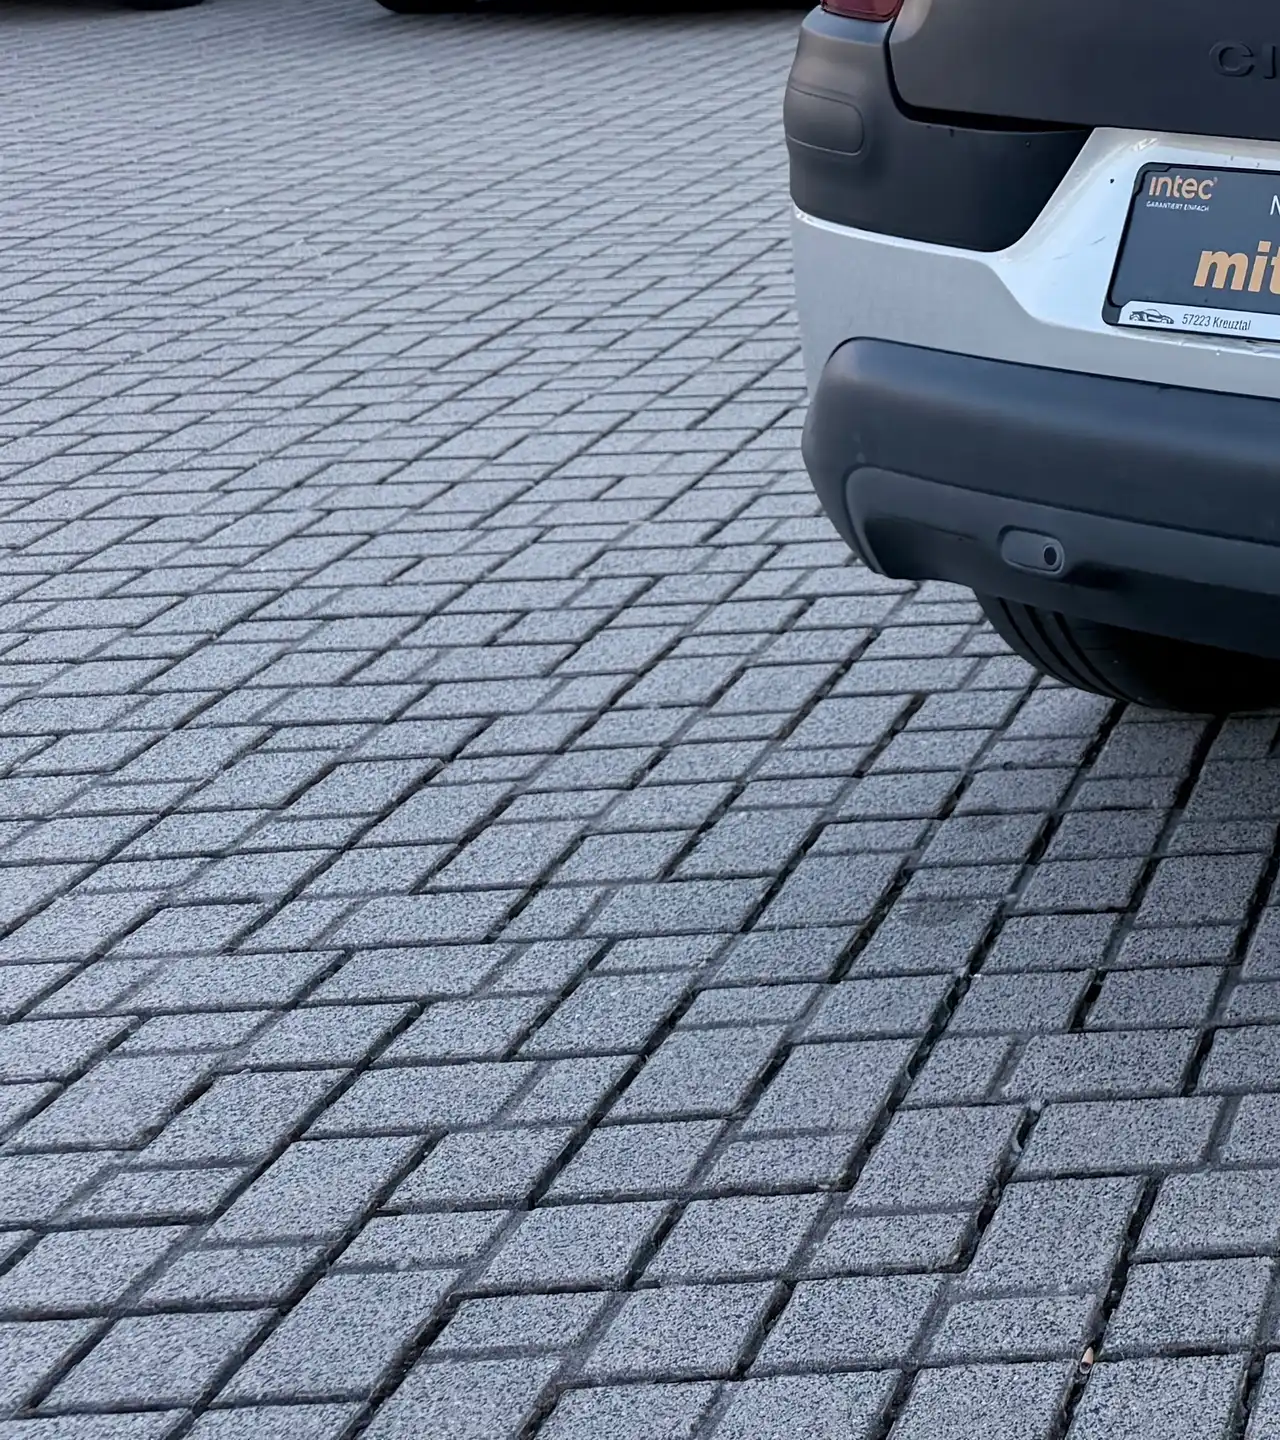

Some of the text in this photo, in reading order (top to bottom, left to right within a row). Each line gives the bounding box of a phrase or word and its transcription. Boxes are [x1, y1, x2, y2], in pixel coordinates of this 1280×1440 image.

[1148, 175, 1214, 200] intec
[1181, 313, 1252, 331] 57223 Kreuztal
